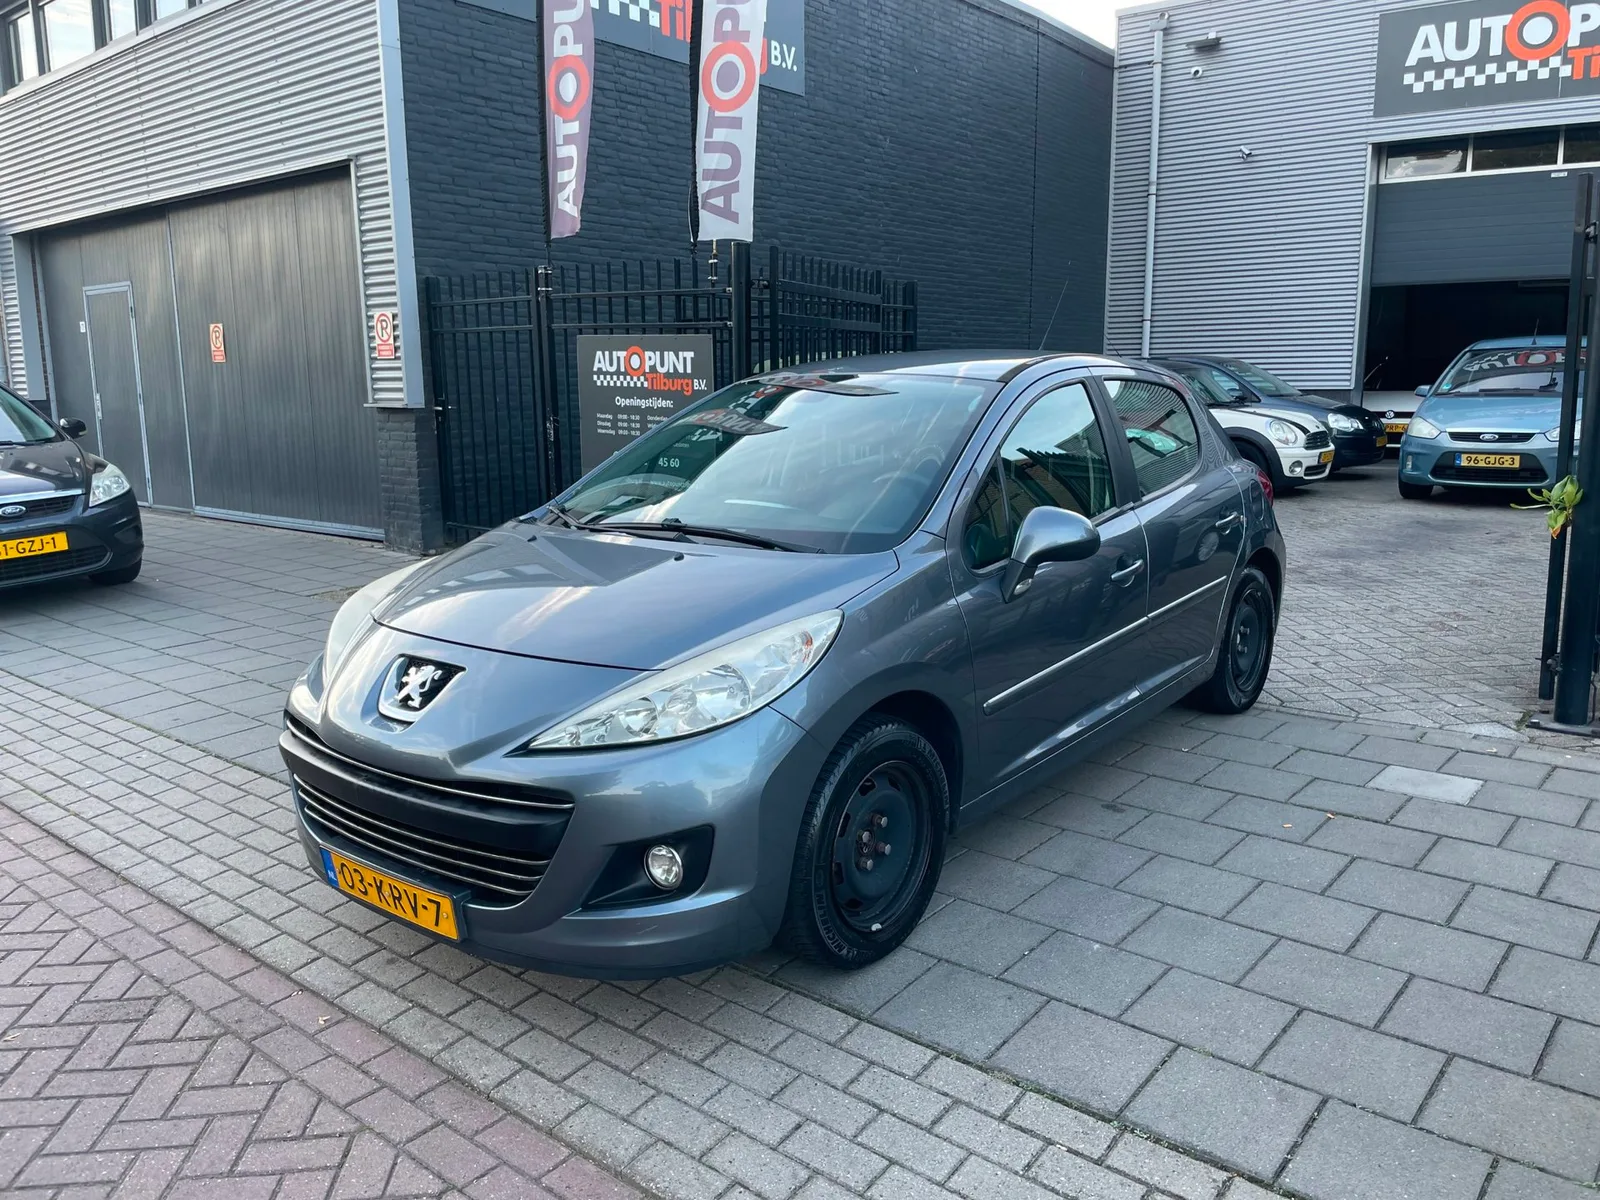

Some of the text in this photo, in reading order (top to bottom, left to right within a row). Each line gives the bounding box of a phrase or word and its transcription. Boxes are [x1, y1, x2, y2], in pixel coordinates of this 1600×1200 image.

[770, 39, 798, 72] B.V.
[593, 345, 694, 377] AUTOPUNT
[646, 372, 707, 396] Tilburg B.V.
[615, 396, 674, 409] Openingstijden:
[658, 458, 680, 468] 45 60
[1466, 456, 1515, 466] 96-GJG-3
[0, 536, 56, 558] 1-GZJ-1
[340, 862, 441, 927] 03-KRV-7
